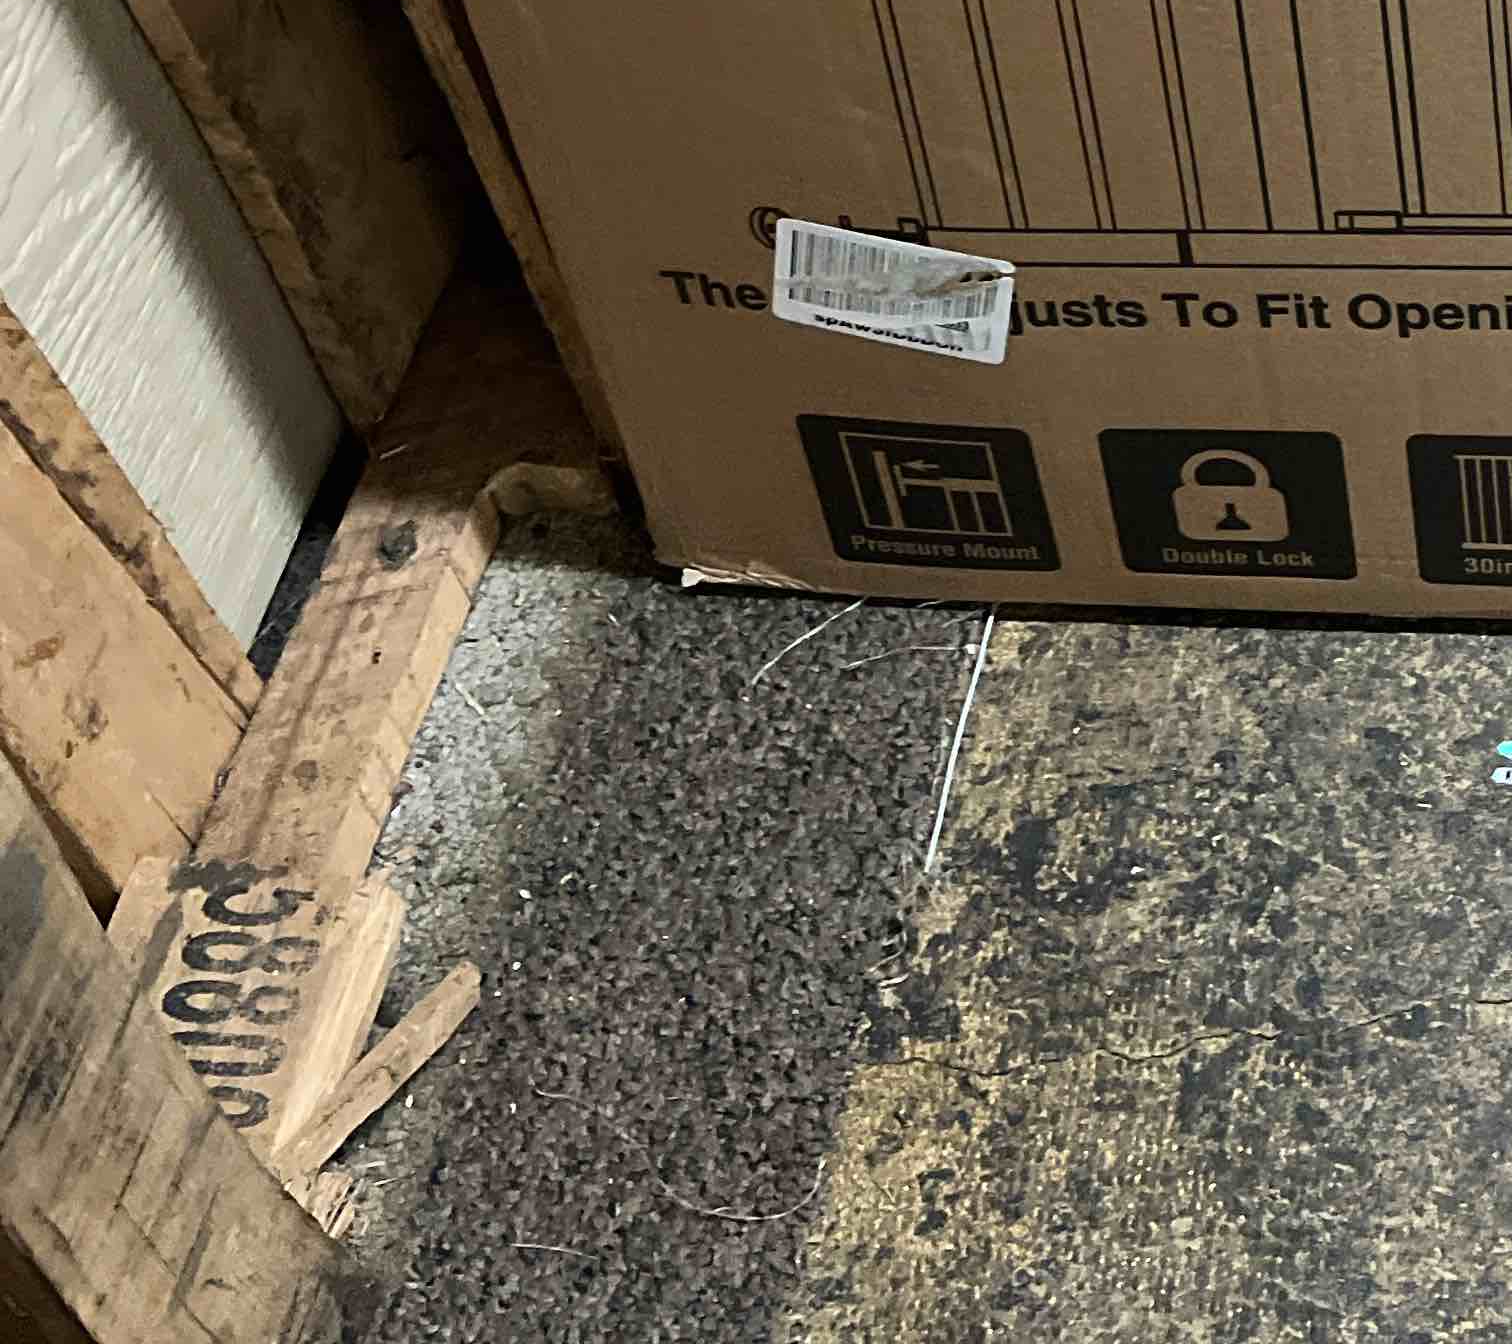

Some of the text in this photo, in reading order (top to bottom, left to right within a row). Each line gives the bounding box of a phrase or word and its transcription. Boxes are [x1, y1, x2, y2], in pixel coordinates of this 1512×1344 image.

[656, 268, 769, 311] The
[1009, 291, 1148, 337] justs
[1165, 292, 1238, 329] To
[1255, 293, 1331, 329] Fit
[851, 534, 1041, 562] Pressure Mount
[1161, 547, 1315, 568] Double Lock
